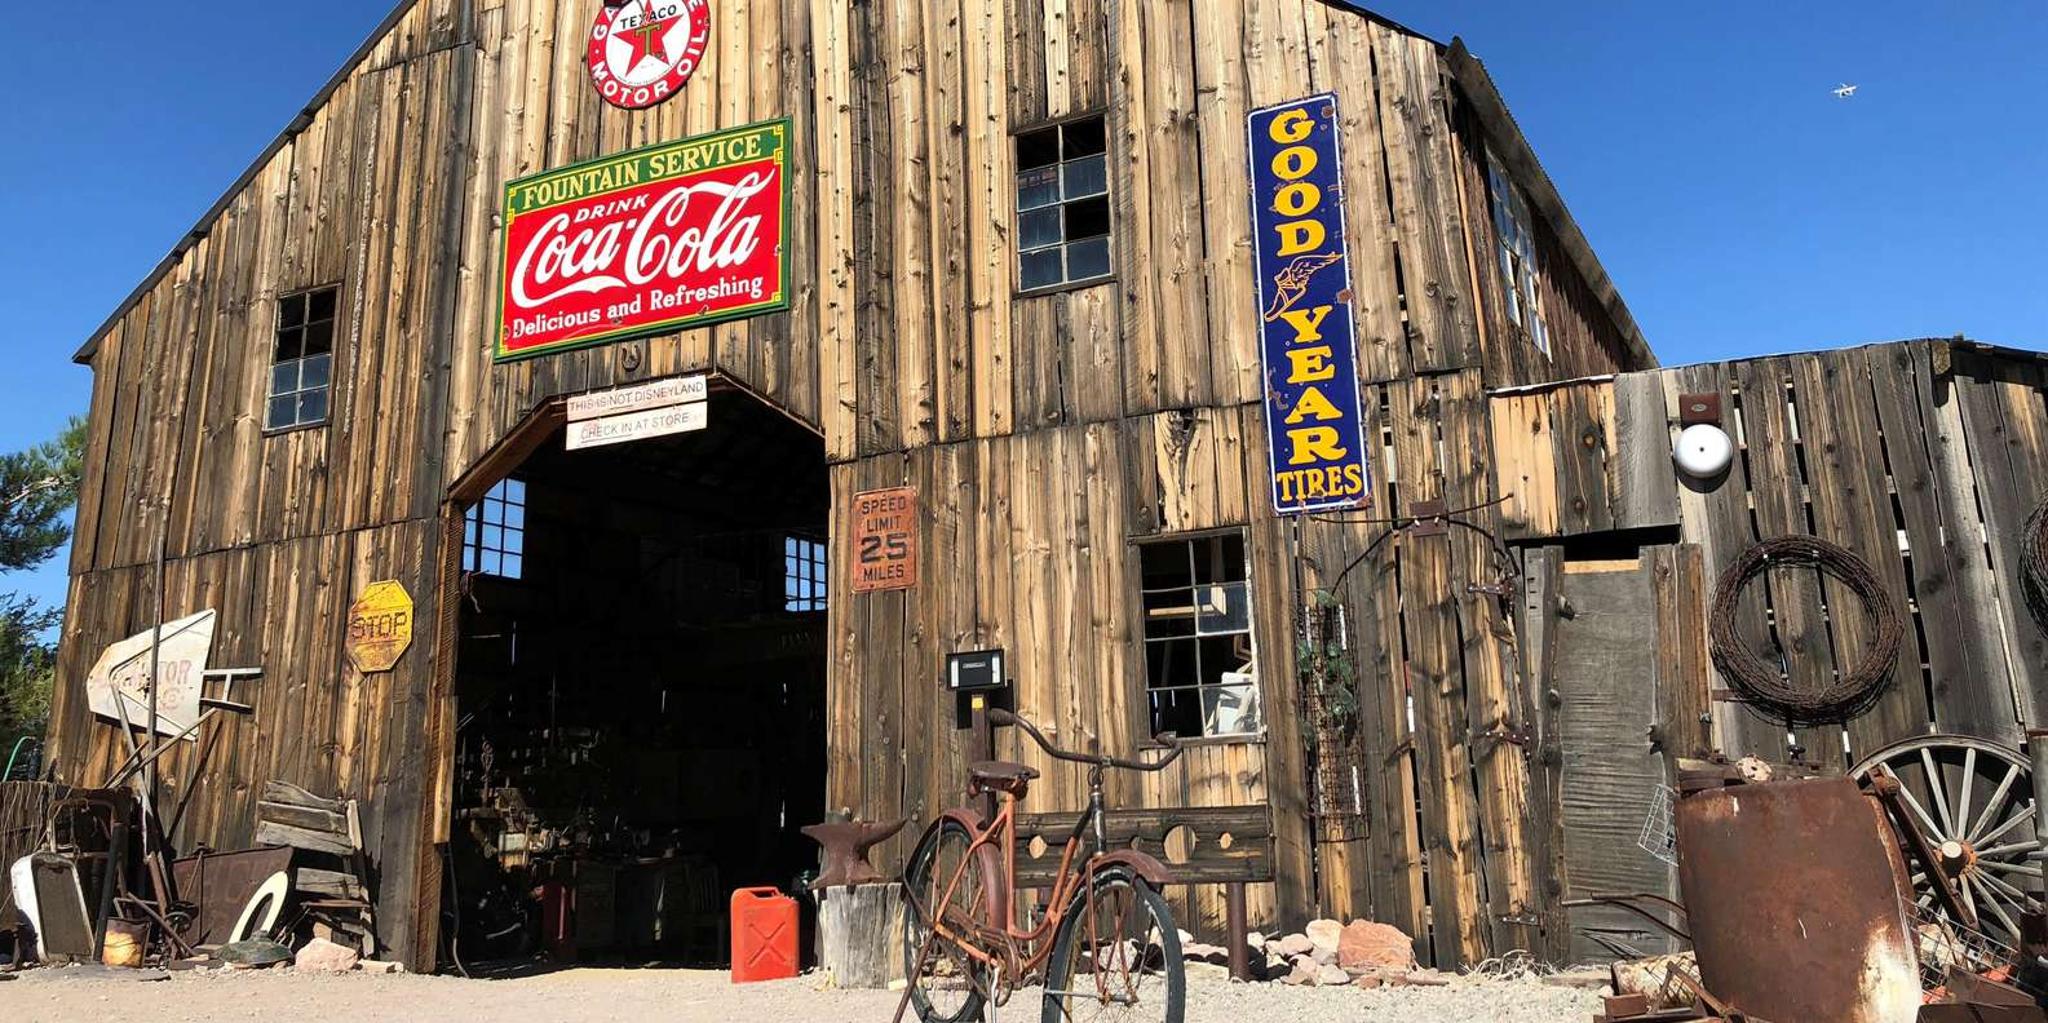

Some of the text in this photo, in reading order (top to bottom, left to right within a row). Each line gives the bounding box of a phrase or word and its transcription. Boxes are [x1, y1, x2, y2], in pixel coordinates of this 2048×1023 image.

[620, 4, 677, 29] TEXACO
[592, 61, 669, 104] MOTOR
[676, 30, 706, 75] OIL
[521, 135, 761, 210] FOUNTAIN SERVICE
[573, 193, 650, 224] DRINK
[511, 168, 775, 309] Coca-Cola
[512, 275, 764, 339] Delicious and Refreshing
[569, 382, 704, 412] THIS IS NOT DISNEYLAND
[580, 412, 689, 439] CHECK IN AT STORE
[1276, 463, 1363, 502] TIRES
[861, 496, 906, 515] SPEED
[867, 515, 902, 532] LIMIT
[861, 533, 907, 563] 25
[863, 564, 905, 582] MILES
[351, 611, 408, 640] STOP
